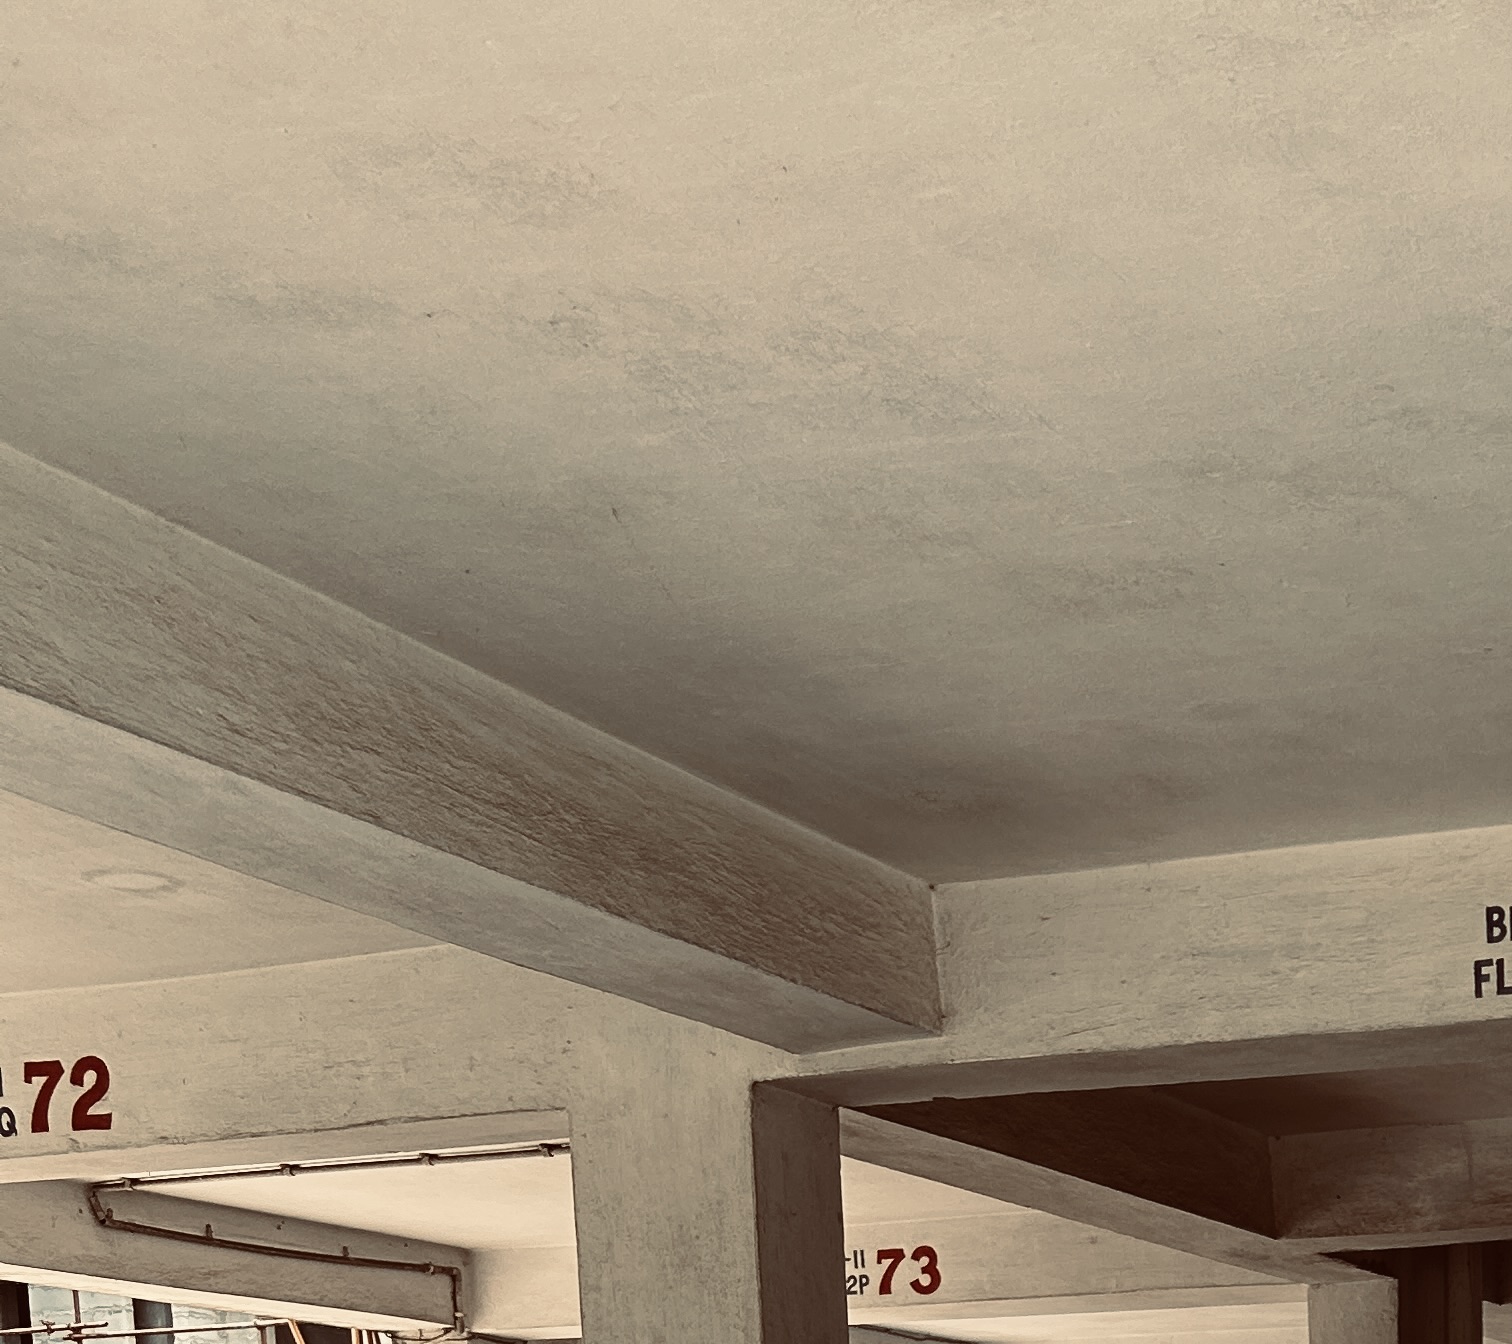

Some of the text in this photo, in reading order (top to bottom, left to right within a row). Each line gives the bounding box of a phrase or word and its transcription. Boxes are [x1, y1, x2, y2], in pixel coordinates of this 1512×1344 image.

[23, 1055, 113, 1134] 72
[846, 1274, 870, 1295] 2P
[876, 1245, 942, 1295] 73
